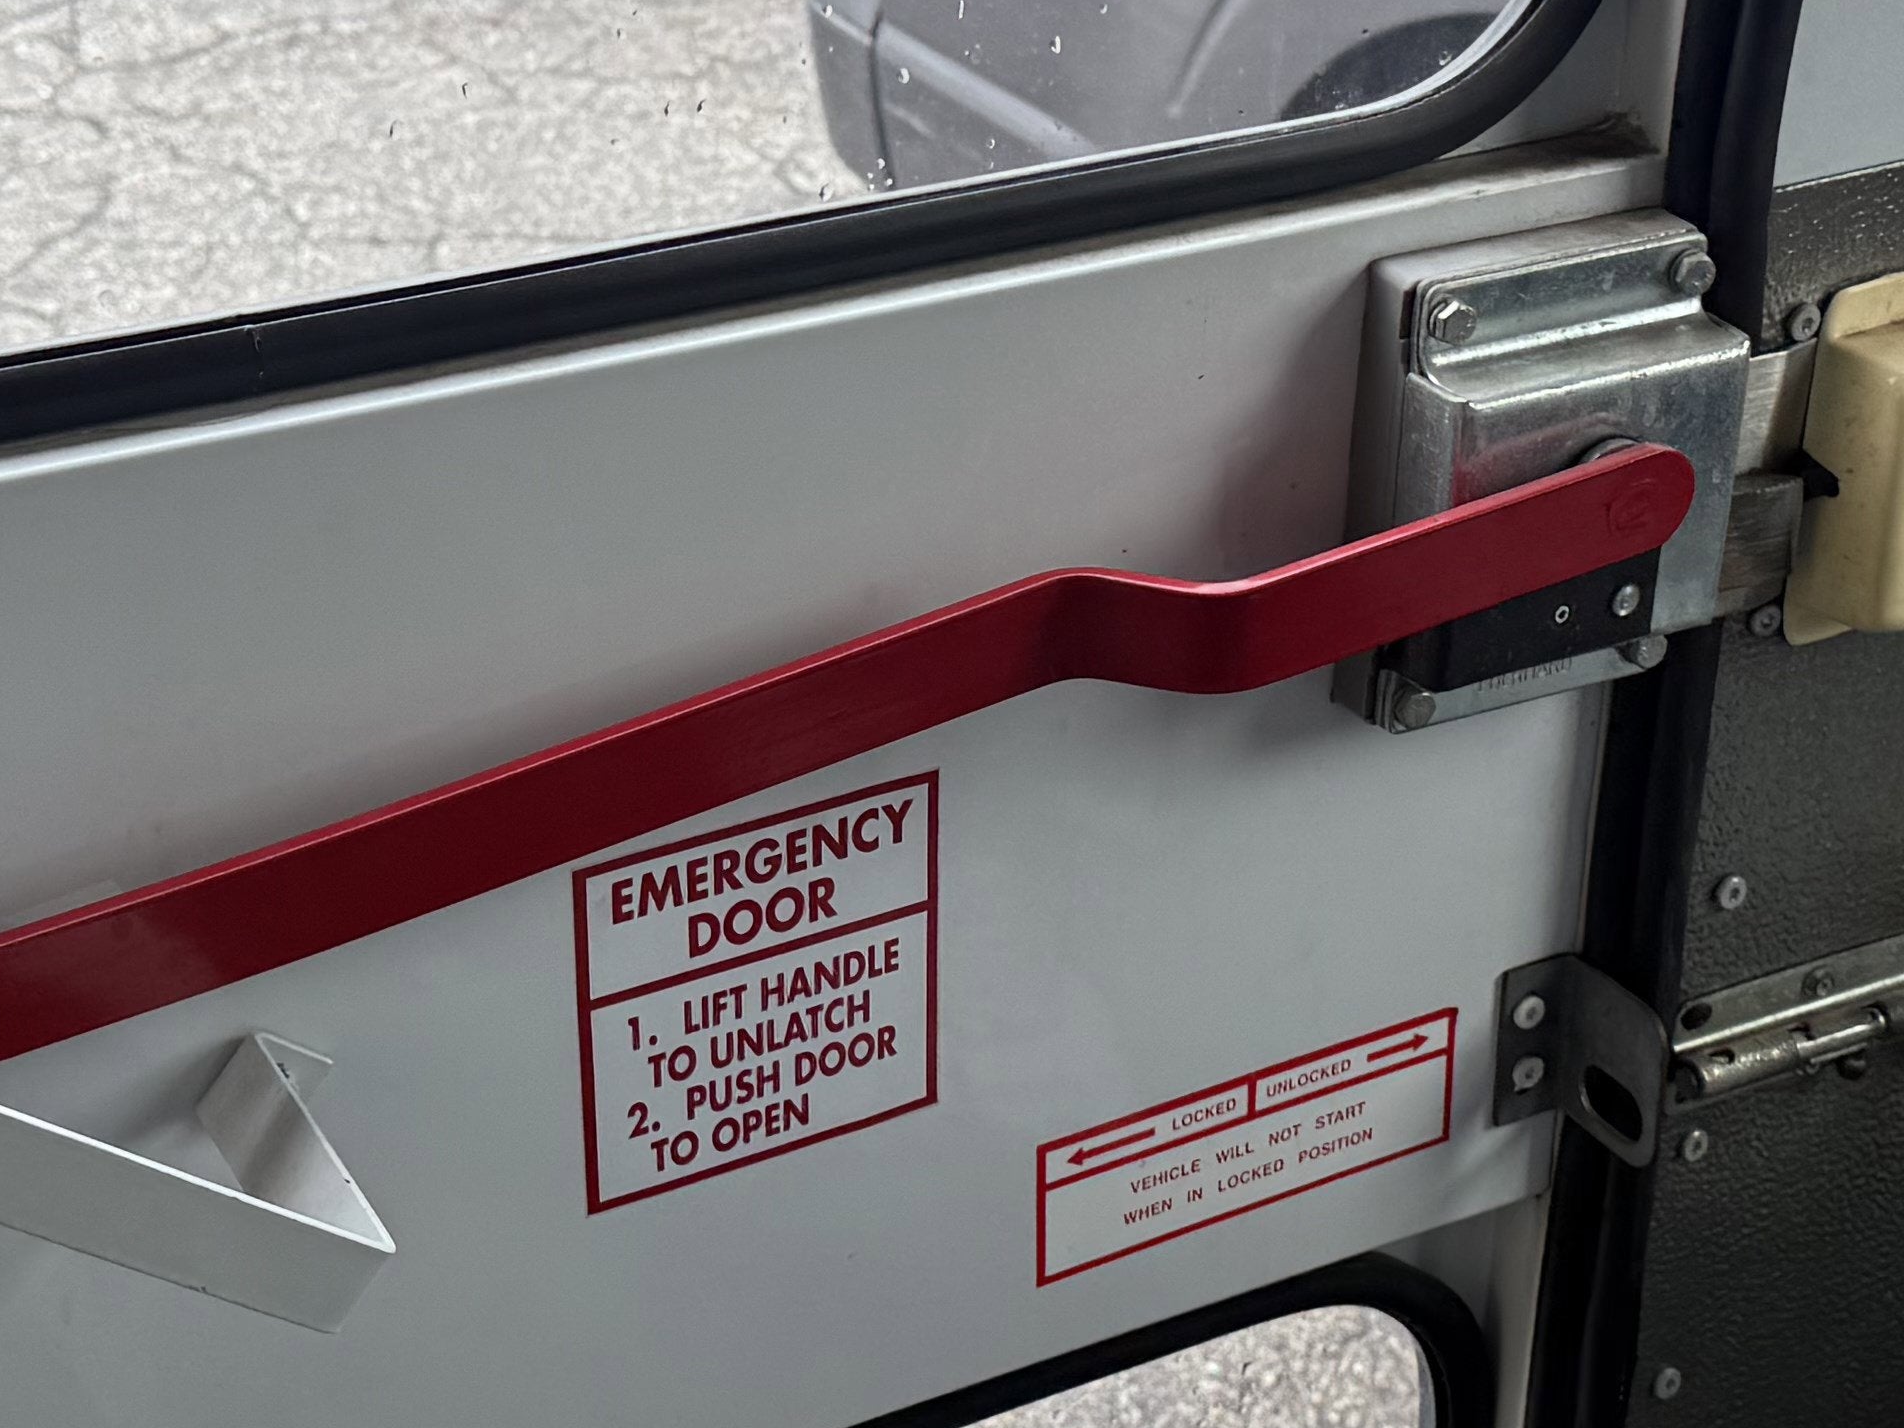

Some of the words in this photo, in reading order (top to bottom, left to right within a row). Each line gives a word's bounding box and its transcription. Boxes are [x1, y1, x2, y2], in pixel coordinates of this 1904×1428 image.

[611, 798, 914, 925] EMERGENCY
[688, 877, 838, 958] DOOR
[628, 1016, 658, 1051] 1.
[683, 984, 747, 1035] LIFT
[760, 937, 900, 1012] HANDLE
[648, 1046, 697, 1088] TO
[710, 989, 871, 1069] UNLATCH
[627, 1101, 661, 1139] 2.
[686, 1061, 781, 1120] PUSH
[795, 1025, 897, 1086] DOOR
[1171, 1097, 1237, 1131] LOCKED
[1266, 1058, 1352, 1098] UNLOCKED
[650, 1130, 699, 1172] TO
[712, 1093, 810, 1152] OPEN
[1123, 1197, 1173, 1225] WHEN
[1186, 1186, 1204, 1203] IN
[1217, 1158, 1285, 1193] LOCKED
[1298, 1127, 1374, 1164] POSITION
[1129, 1158, 1202, 1194] VEHICLE
[1215, 1142, 1255, 1165] WILL
[1268, 1123, 1302, 1147] NOT
[1315, 1101, 1367, 1130] START
